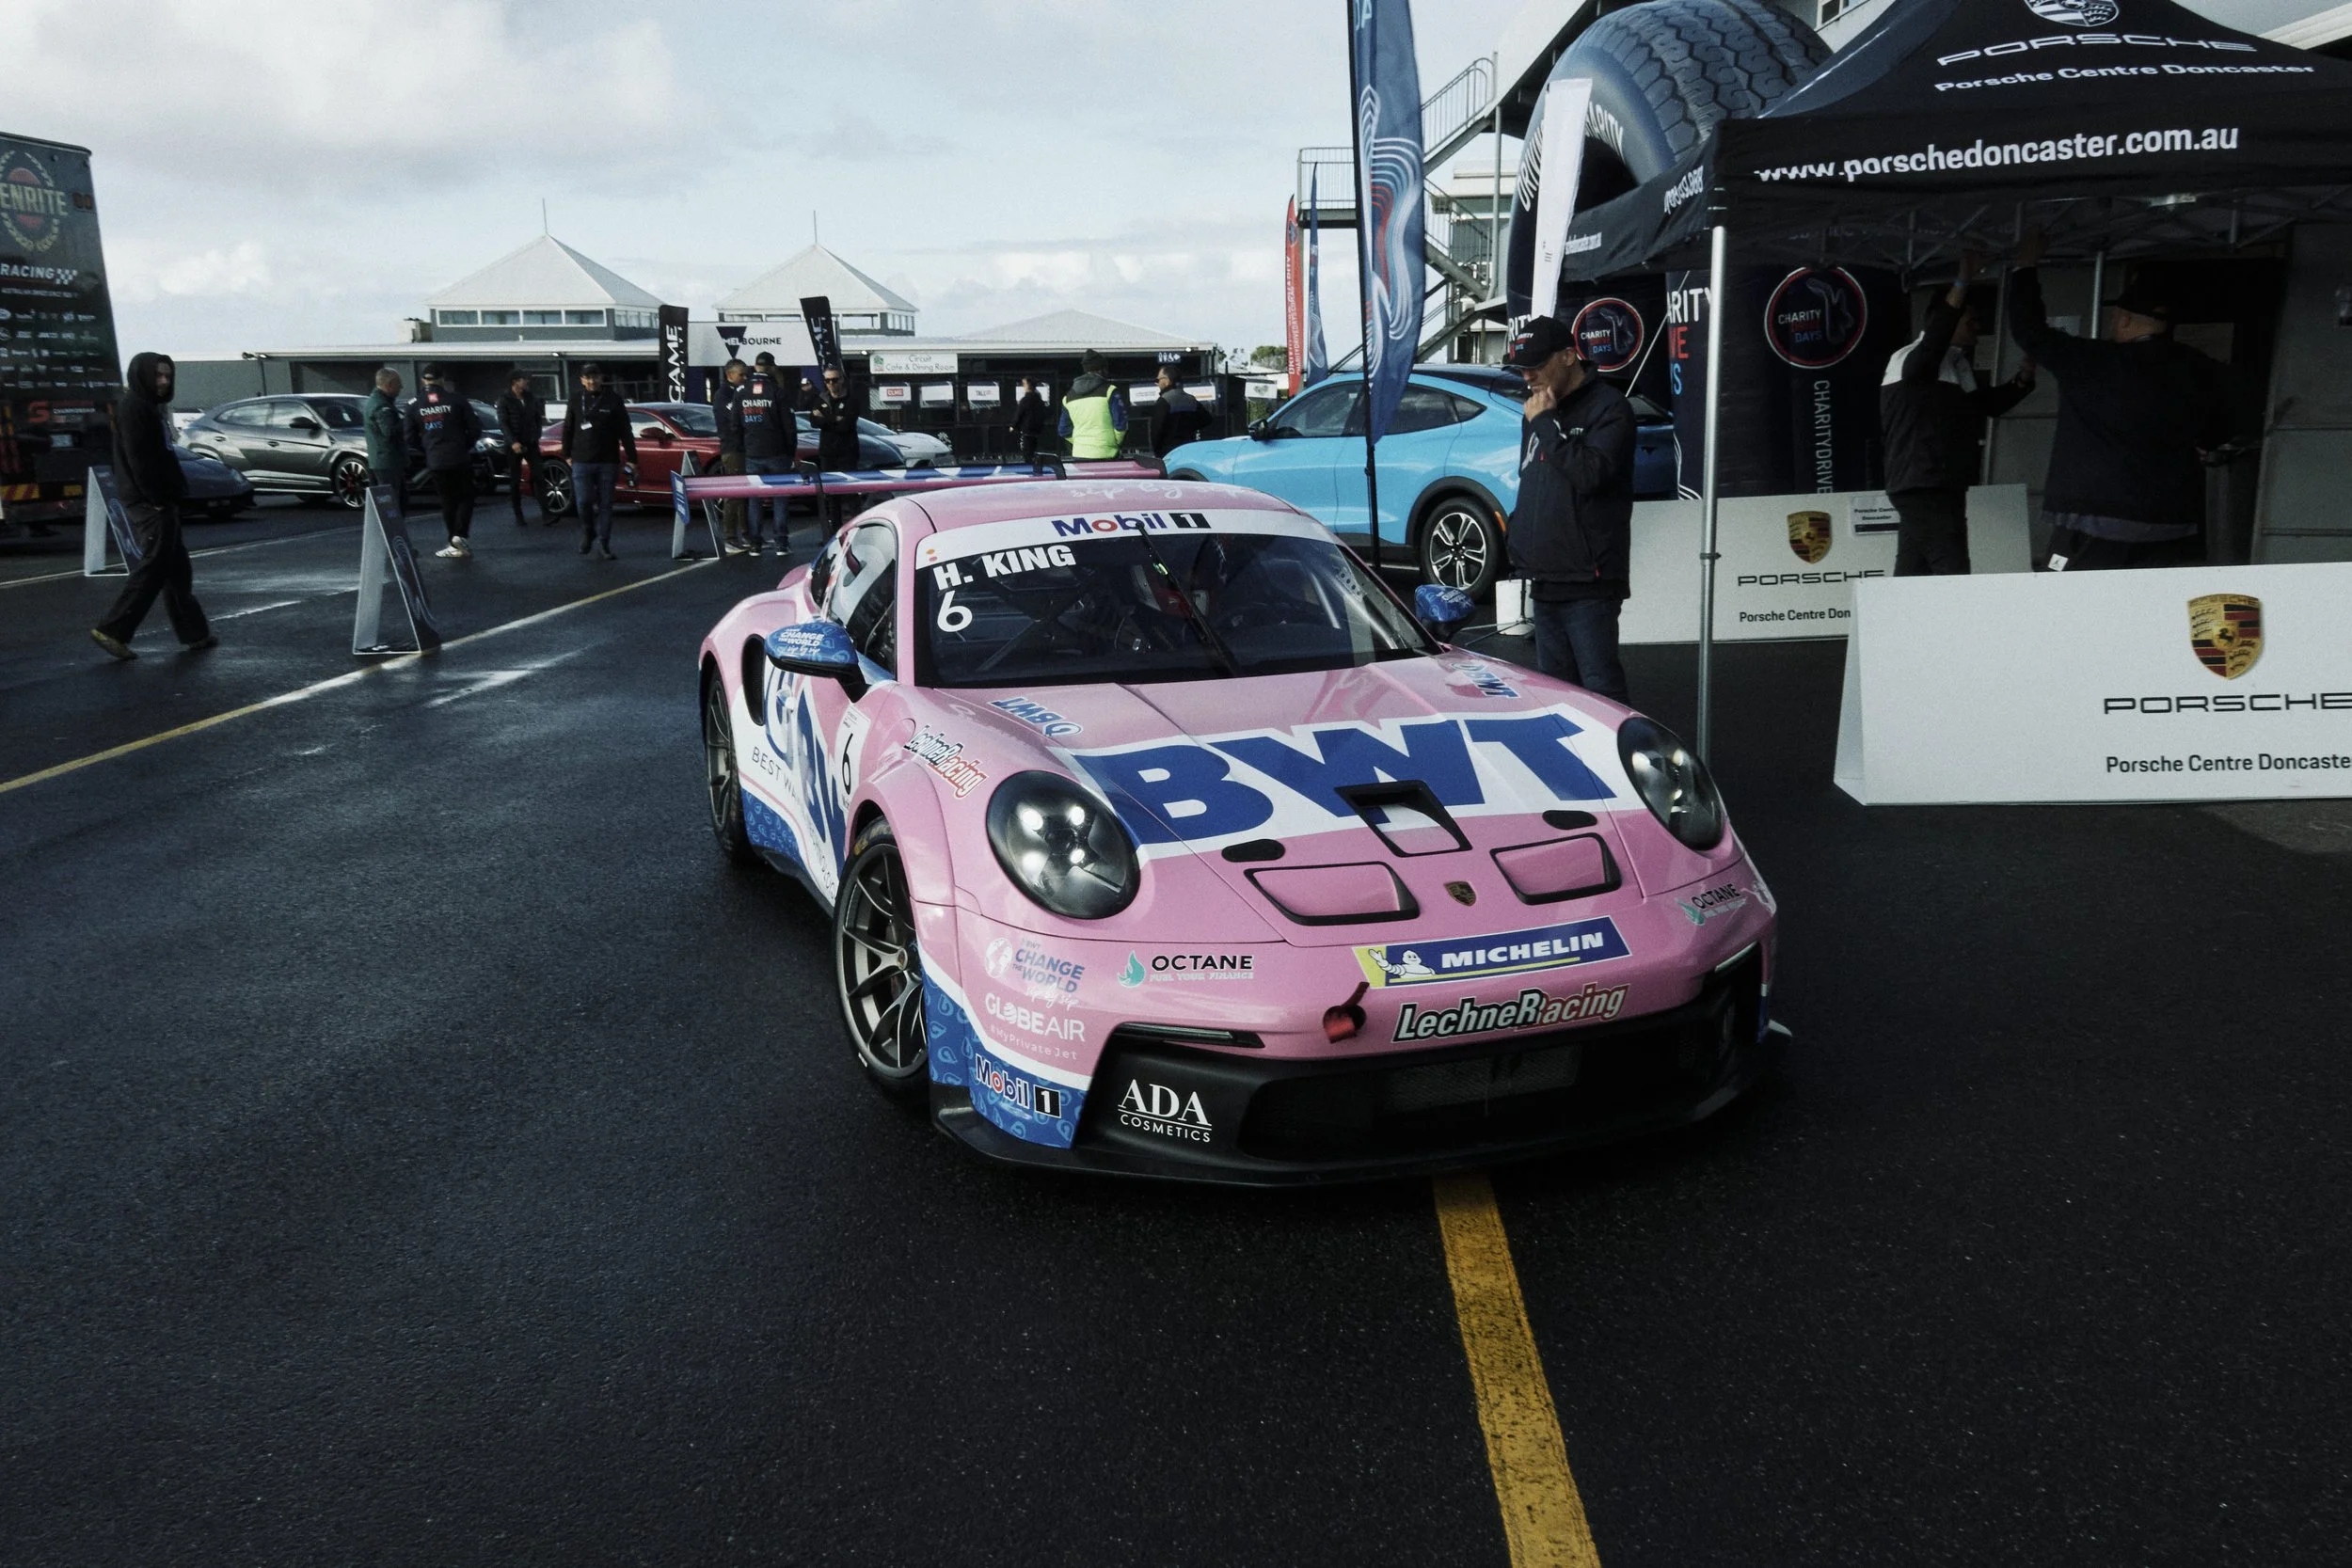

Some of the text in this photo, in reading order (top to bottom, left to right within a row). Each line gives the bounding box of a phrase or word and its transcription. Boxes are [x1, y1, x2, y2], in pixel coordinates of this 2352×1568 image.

[1936, 33, 2258, 67] PORSCHE
[1934, 63, 2314, 92] Porsche Centre Doncaster
[1754, 127, 2239, 182] www.porschedoncaster.com.au
[0, 182, 69, 216] ENRITE
[0, 263, 56, 279] RACING
[1777, 309, 1822, 325] CHARITY
[1581, 329, 1612, 341] CHARITY
[1794, 331, 1823, 343] DAYS
[908, 354, 932, 362] Circuit
[1593, 344, 1613, 354] DAYS
[666, 325, 682, 404] GAME
[912, 363, 934, 372] Dining
[420, 405, 452, 417] CHARITY
[742, 399, 772, 408] CHARITY
[1814, 379, 1834, 494] CHARITYDRIVE
[1051, 513, 1168, 537] Mobil
[932, 545, 1076, 591] H. KING
[1738, 569, 1884, 587] PORSCHE
[936, 591, 974, 633] 6
[1740, 608, 1851, 623] Porsche Centre Don
[780, 631, 825, 641] CHANGE
[787, 638, 821, 646] WORLD
[988, 697, 1065, 725] BWT
[2104, 692, 2352, 715] PORSCHE
[752, 746, 782, 783] BEST
[842, 732, 854, 796] 6
[2106, 752, 2351, 773] Porsche Centre Doncaste
[1074, 714, 1617, 845] BWT
[1692, 883, 1741, 910] OCTANE
[1152, 954, 1254, 972] OCTANE
[1441, 930, 1604, 970] MICHELIN
[1015, 948, 1086, 980] CHANGE
[1022, 968, 1078, 993] WORLD
[985, 992, 1086, 1042] GLOBEAIR
[1394, 984, 1629, 1042] LechneRacing
[975, 1054, 1030, 1109] Mobil
[1118, 1078, 1213, 1126] ADA
[1120, 1114, 1212, 1143] COSMETICS
